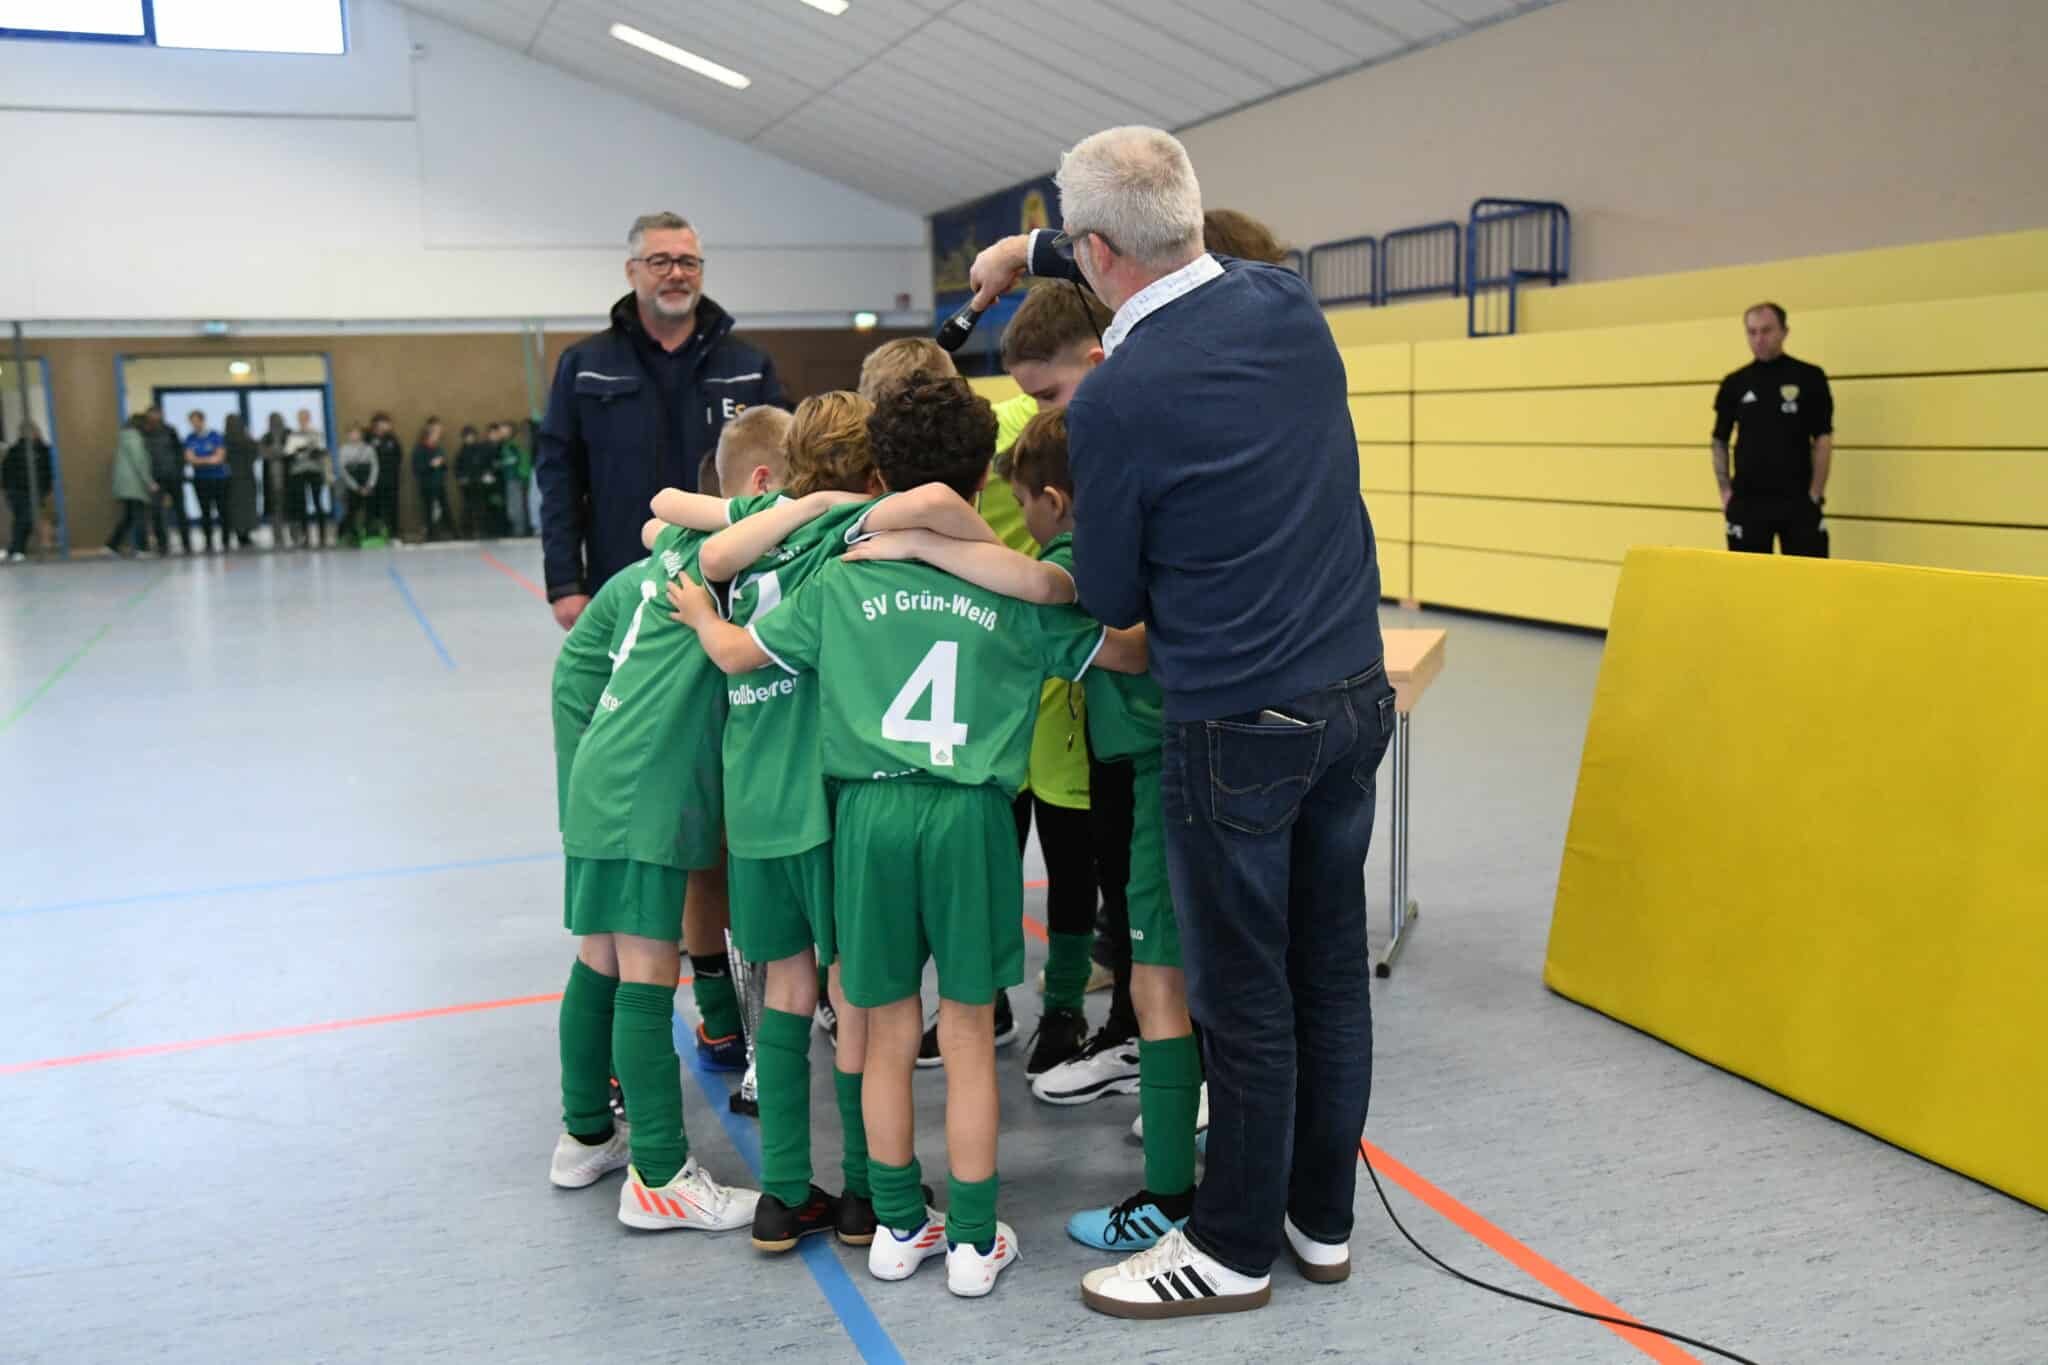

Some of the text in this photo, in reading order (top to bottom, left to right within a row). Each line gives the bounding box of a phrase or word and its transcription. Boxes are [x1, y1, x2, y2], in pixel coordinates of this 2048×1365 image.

[862, 590, 998, 631] SV Grün-Weiß
[881, 640, 969, 766] 4
